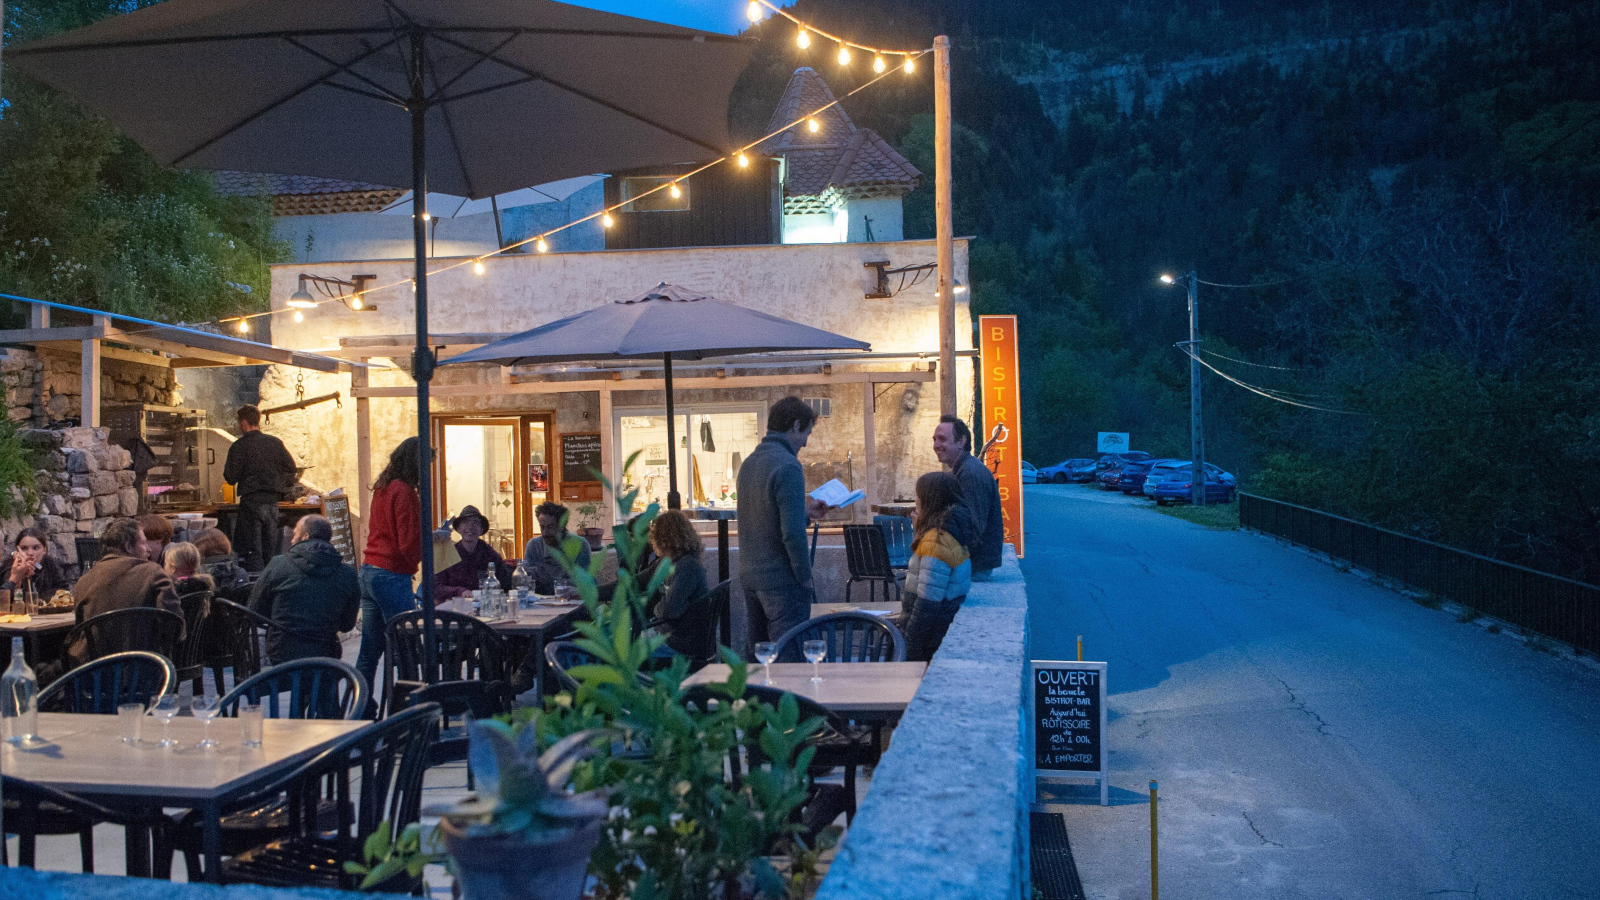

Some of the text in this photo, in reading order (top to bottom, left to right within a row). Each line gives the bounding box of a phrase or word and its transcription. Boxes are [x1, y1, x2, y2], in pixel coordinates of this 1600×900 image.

[1038, 670, 1098, 685] OUVERT
[1049, 686, 1085, 696] la boucle
[1050, 708, 1086, 719] Aujourd'hui
[1042, 717, 1090, 729] RÔTISSOIRE
[1050, 734, 1065, 743] 12h
[1055, 754, 1094, 763] EMPORTER
